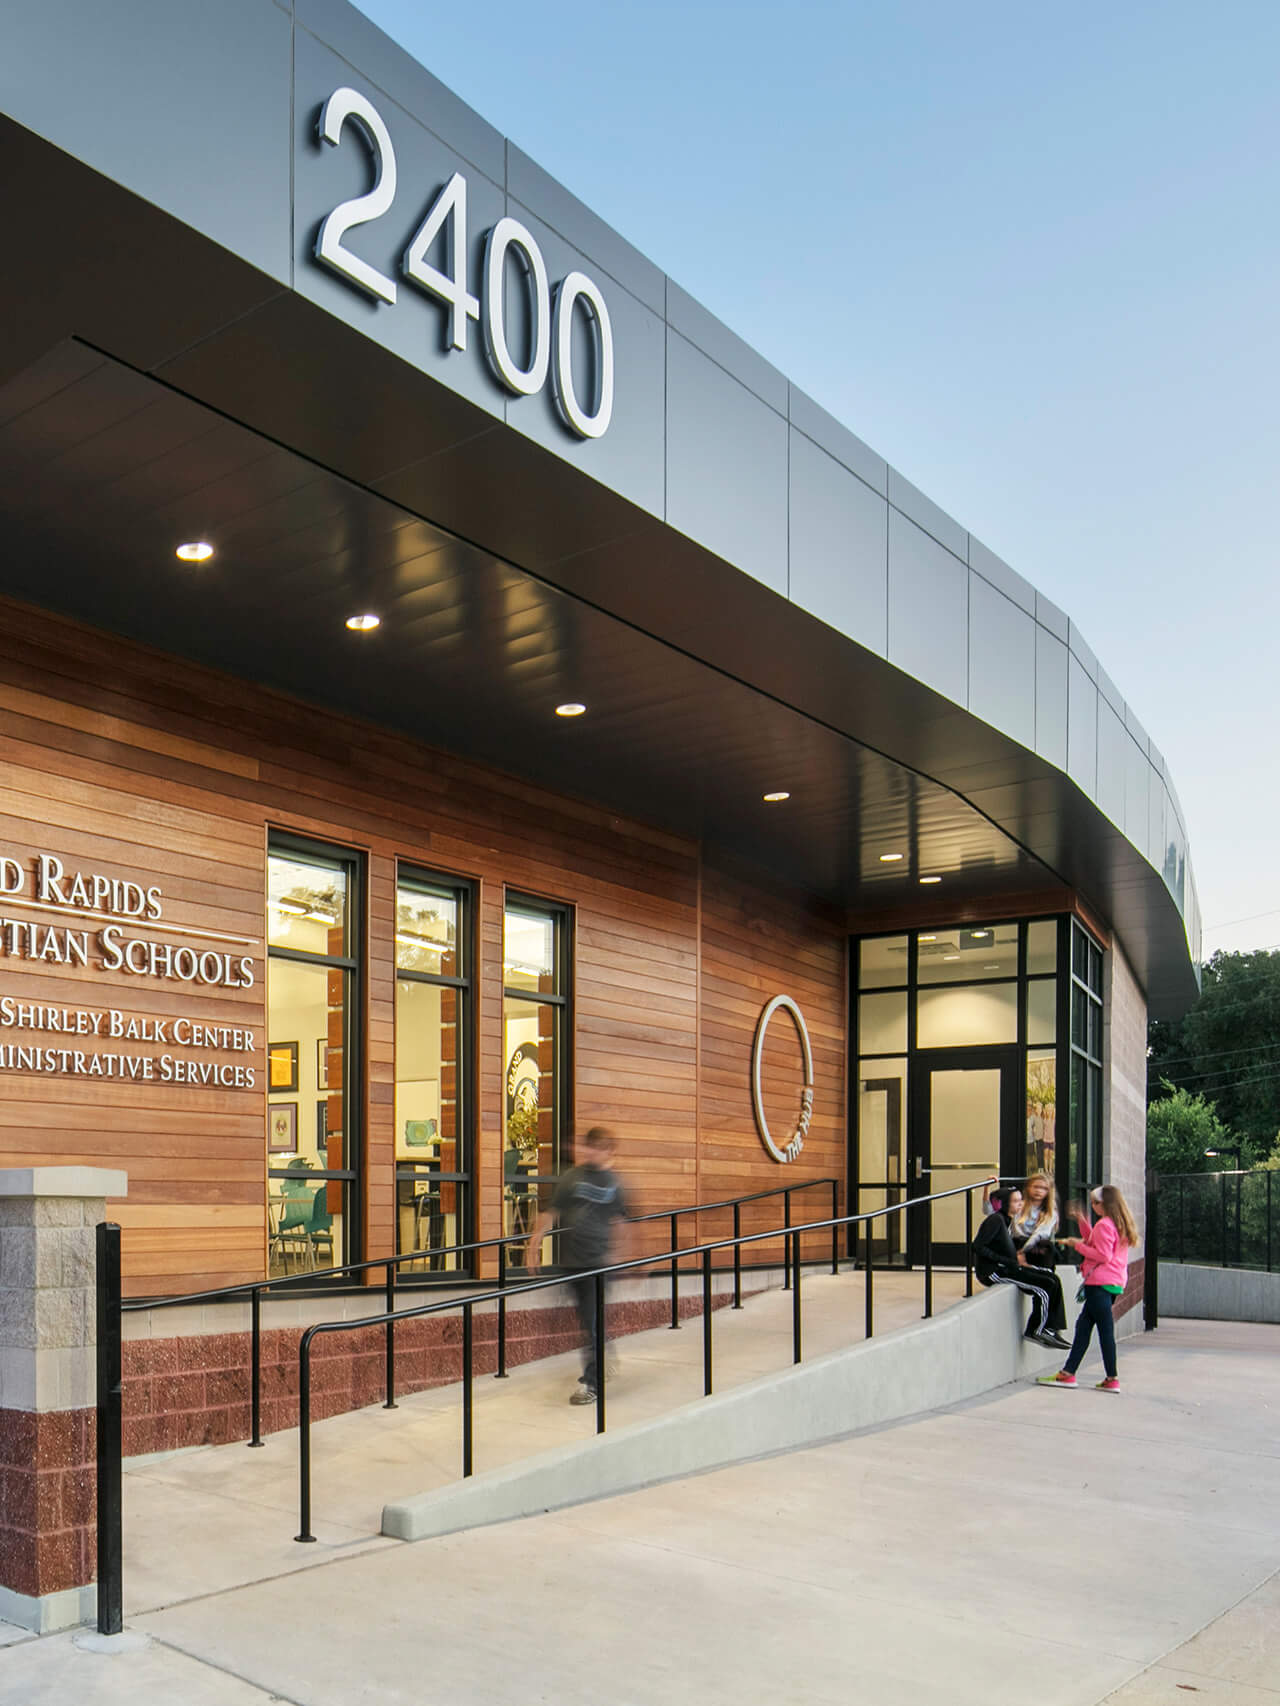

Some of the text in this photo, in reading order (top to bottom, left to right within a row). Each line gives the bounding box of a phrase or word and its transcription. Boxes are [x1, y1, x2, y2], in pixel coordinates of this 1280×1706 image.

[316, 87, 614, 440] 2400
[39, 853, 162, 920] RAPIDS
[102, 925, 255, 988] SCHOOLS
[0, 996, 104, 1035] SHIRLEY
[109, 1009, 167, 1043] BALK
[173, 1018, 256, 1052] CENTER
[160, 1054, 256, 1089] SERVICES
